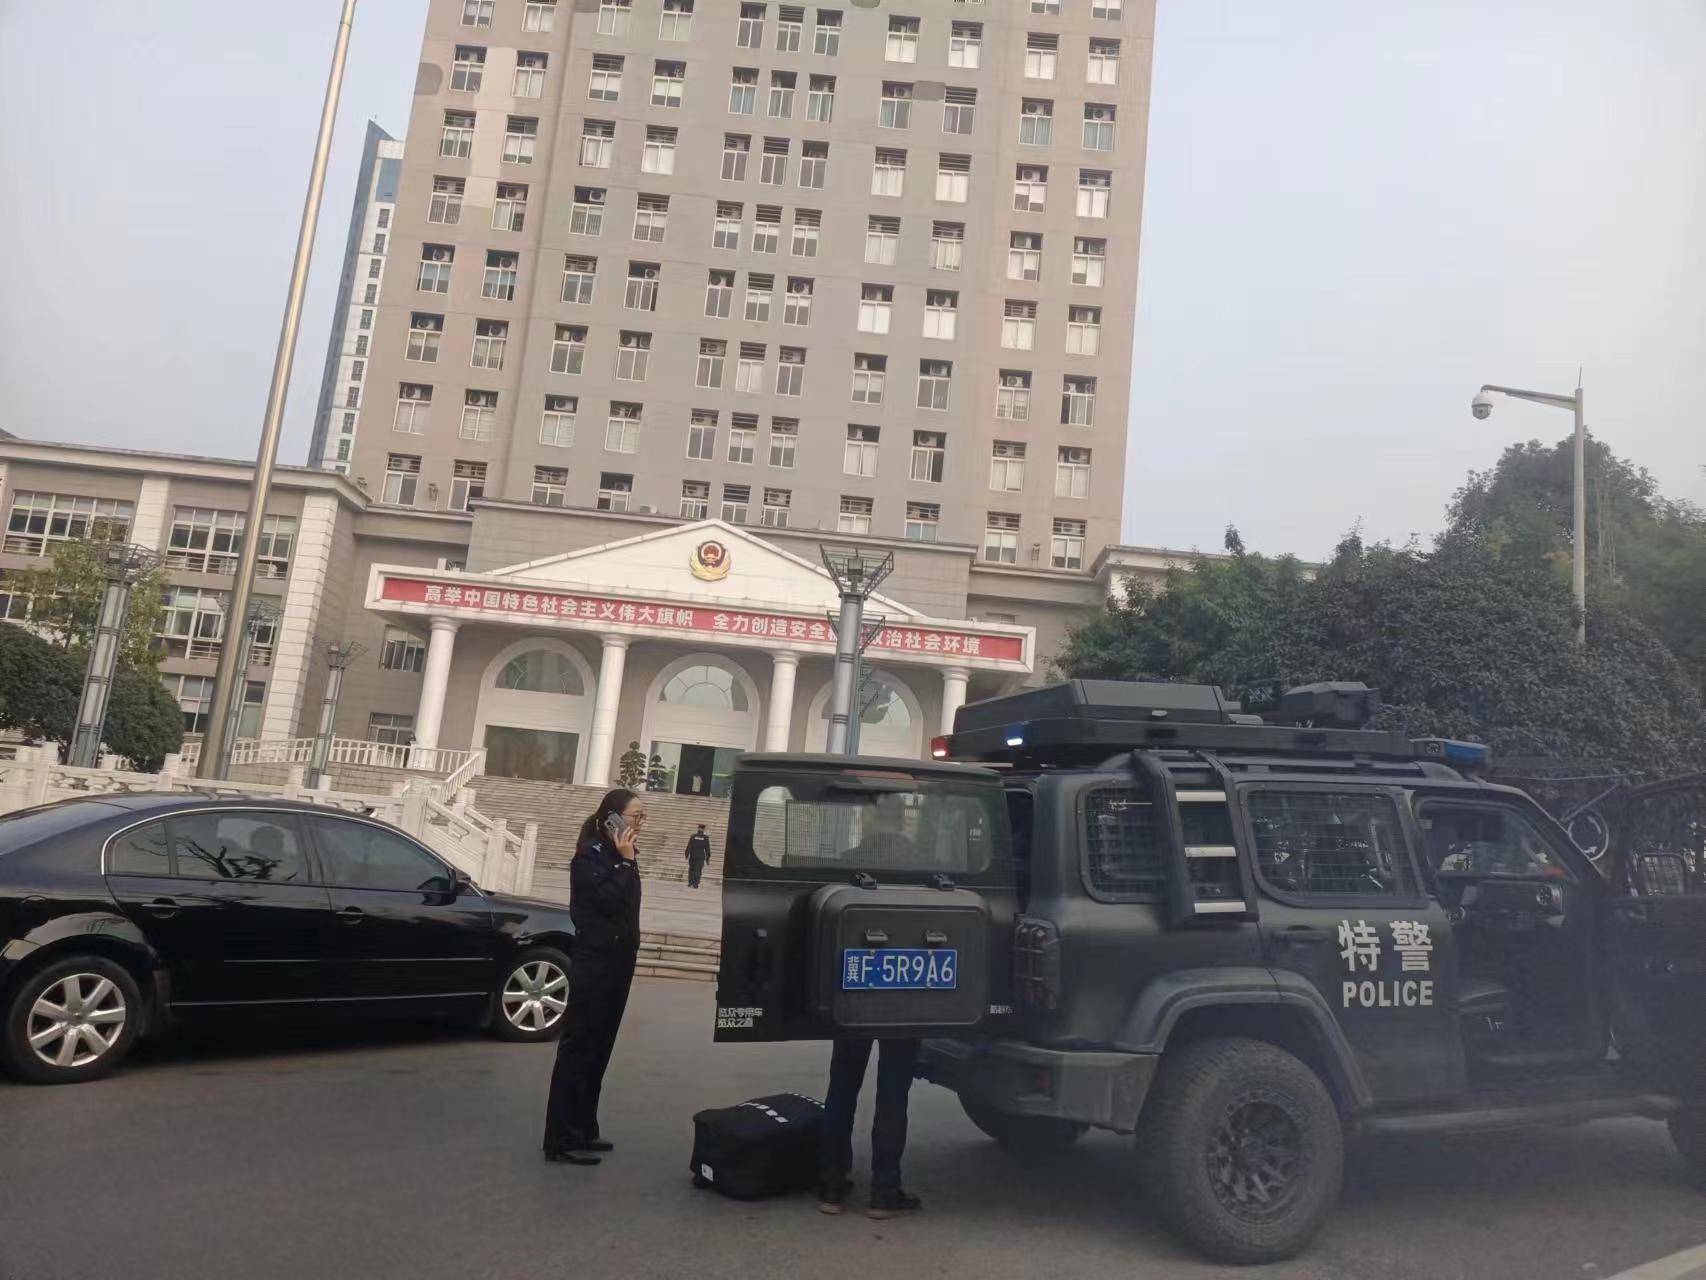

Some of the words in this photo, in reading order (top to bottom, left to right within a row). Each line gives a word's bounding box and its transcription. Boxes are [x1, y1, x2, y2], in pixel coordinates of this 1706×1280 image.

[424, 584, 693, 627] 高举中国特色社会主义伟大旗帜
[712, 612, 981, 655] 全力创造安全治社会环境
[1338, 919, 1433, 971] 特警
[1343, 980, 1433, 1008] POLICE
